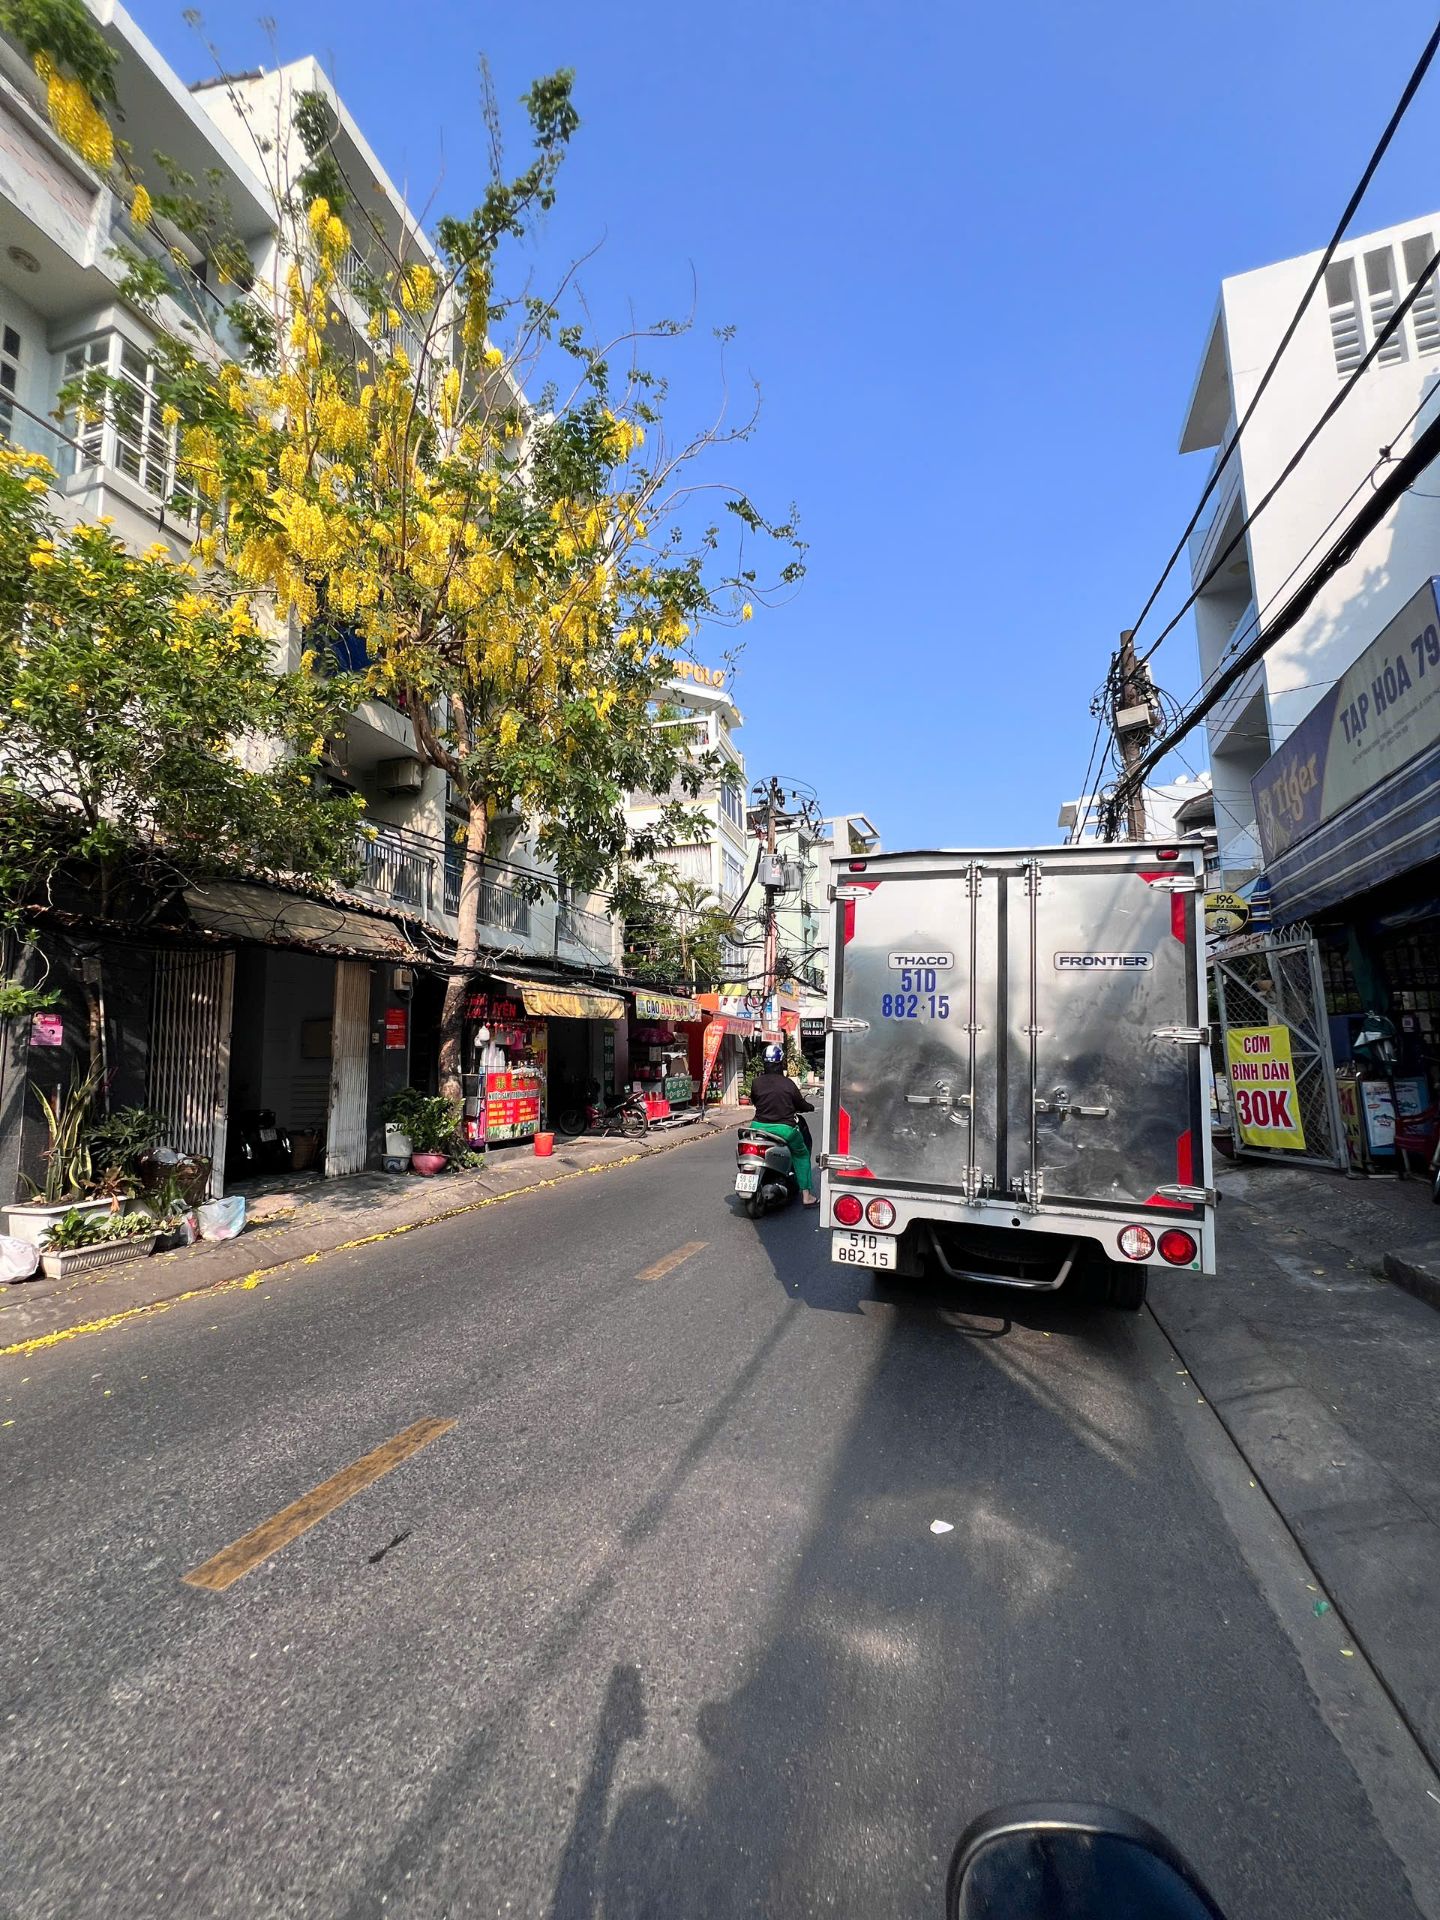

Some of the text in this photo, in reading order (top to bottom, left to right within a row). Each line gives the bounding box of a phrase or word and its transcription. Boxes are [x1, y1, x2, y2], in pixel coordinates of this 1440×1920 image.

[1340, 692, 1369, 748] TẠP
[1371, 656, 1412, 717] HÓA
[1410, 623, 1440, 679] 79
[1272, 752, 1319, 821] Tiger
[894, 956, 948, 966] THACO
[1059, 956, 1148, 966] FRONTIER
[901, 968, 937, 993] 51D
[1243, 1034, 1271, 1054] CƠM
[1231, 1058, 1291, 1081] BÌNH DÂN
[1235, 1090, 1294, 1128] 30K
[850, 1233, 878, 1250] 51D
[838, 1247, 889, 1267] 882.15
